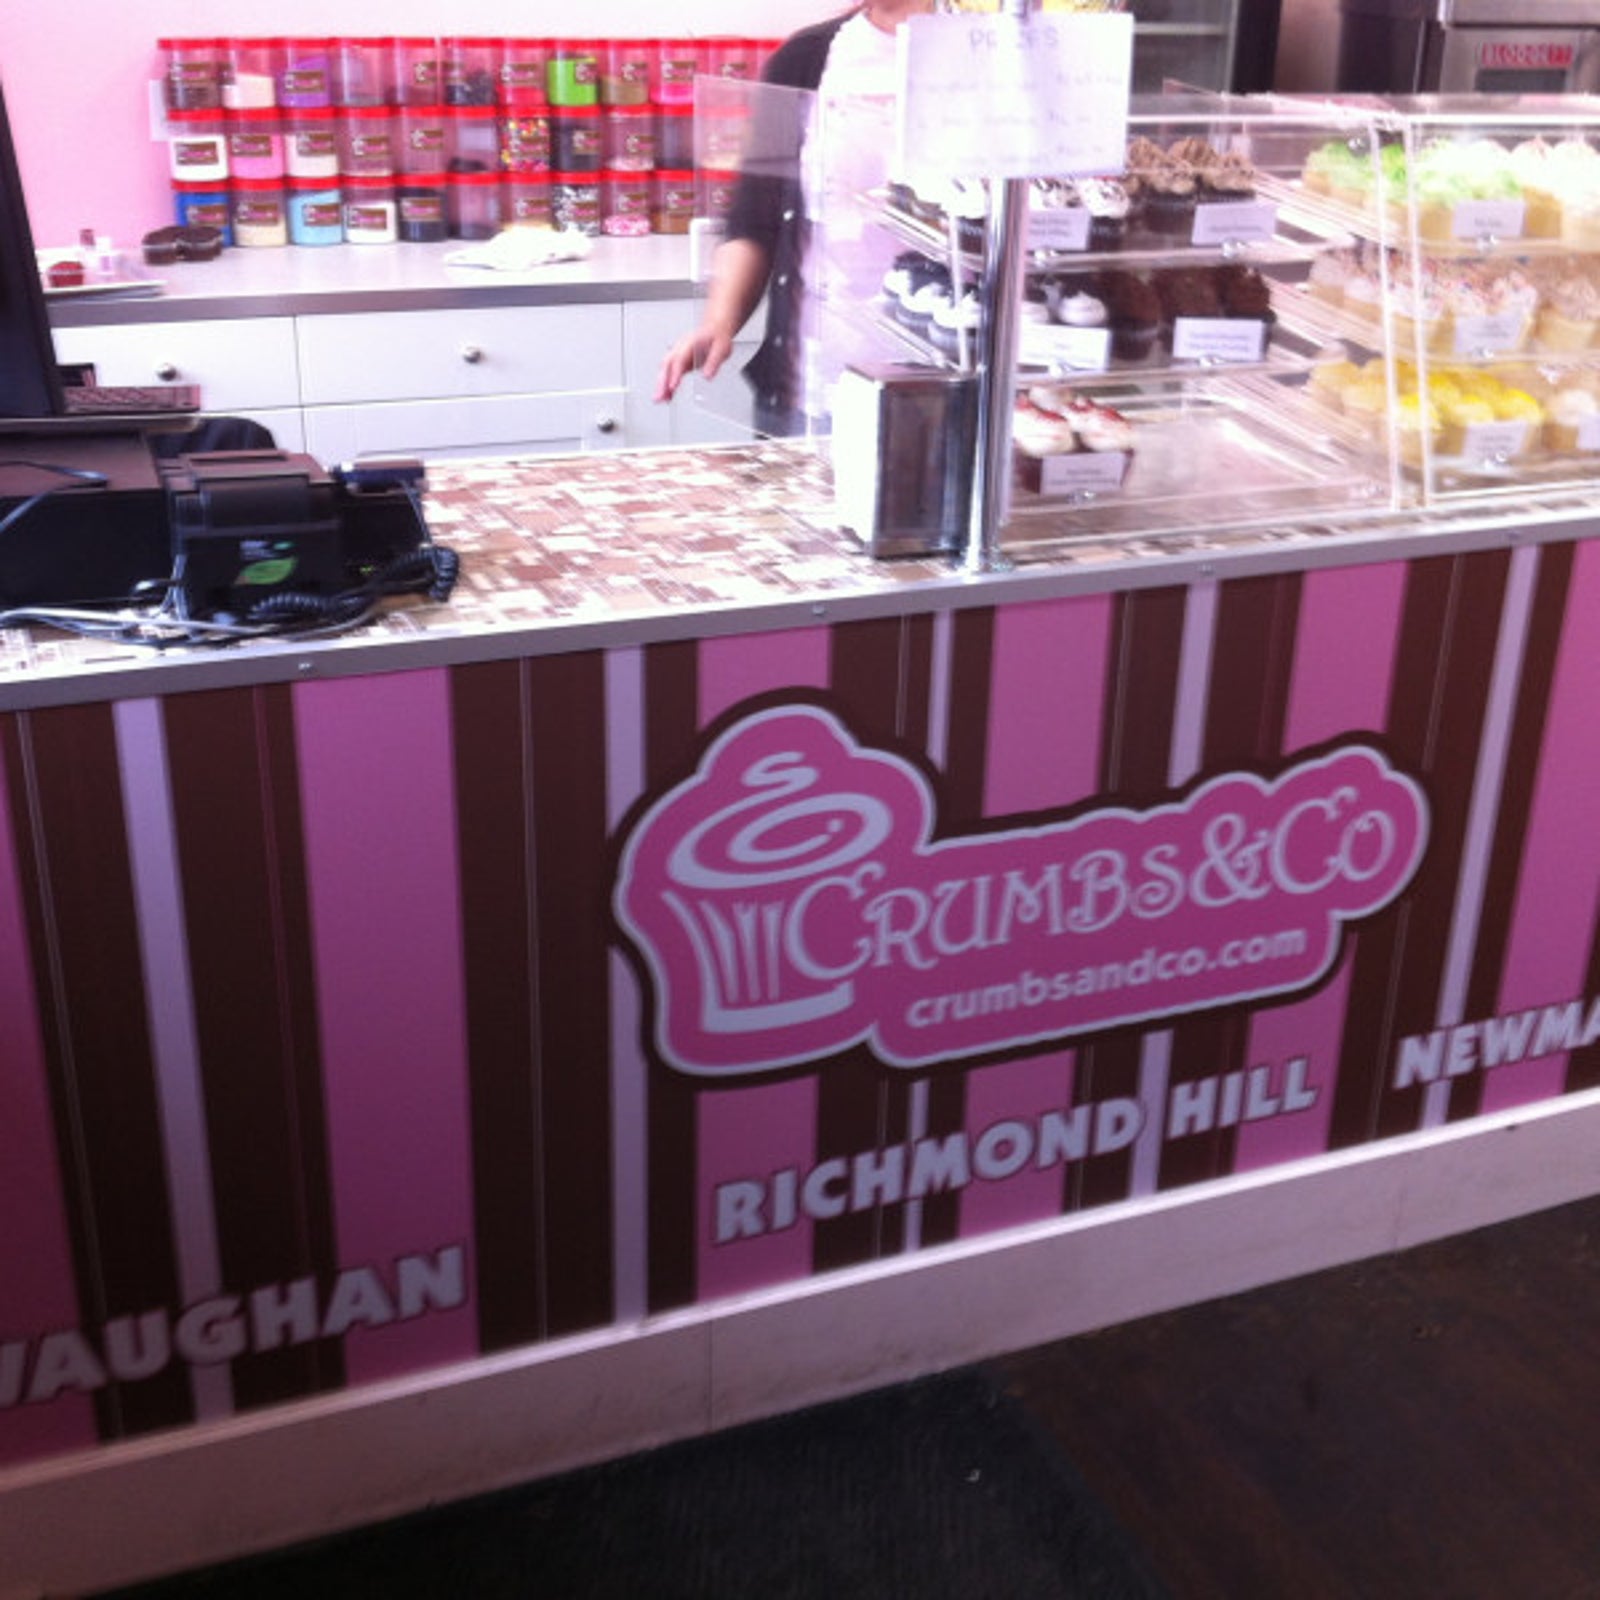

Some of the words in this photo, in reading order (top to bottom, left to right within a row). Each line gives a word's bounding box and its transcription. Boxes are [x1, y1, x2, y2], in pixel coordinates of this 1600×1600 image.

[906, 928, 1307, 1029] crumbsandco.com
[714, 1097, 1146, 1244] RICHMOND
[1167, 1058, 1318, 1139] HILL
